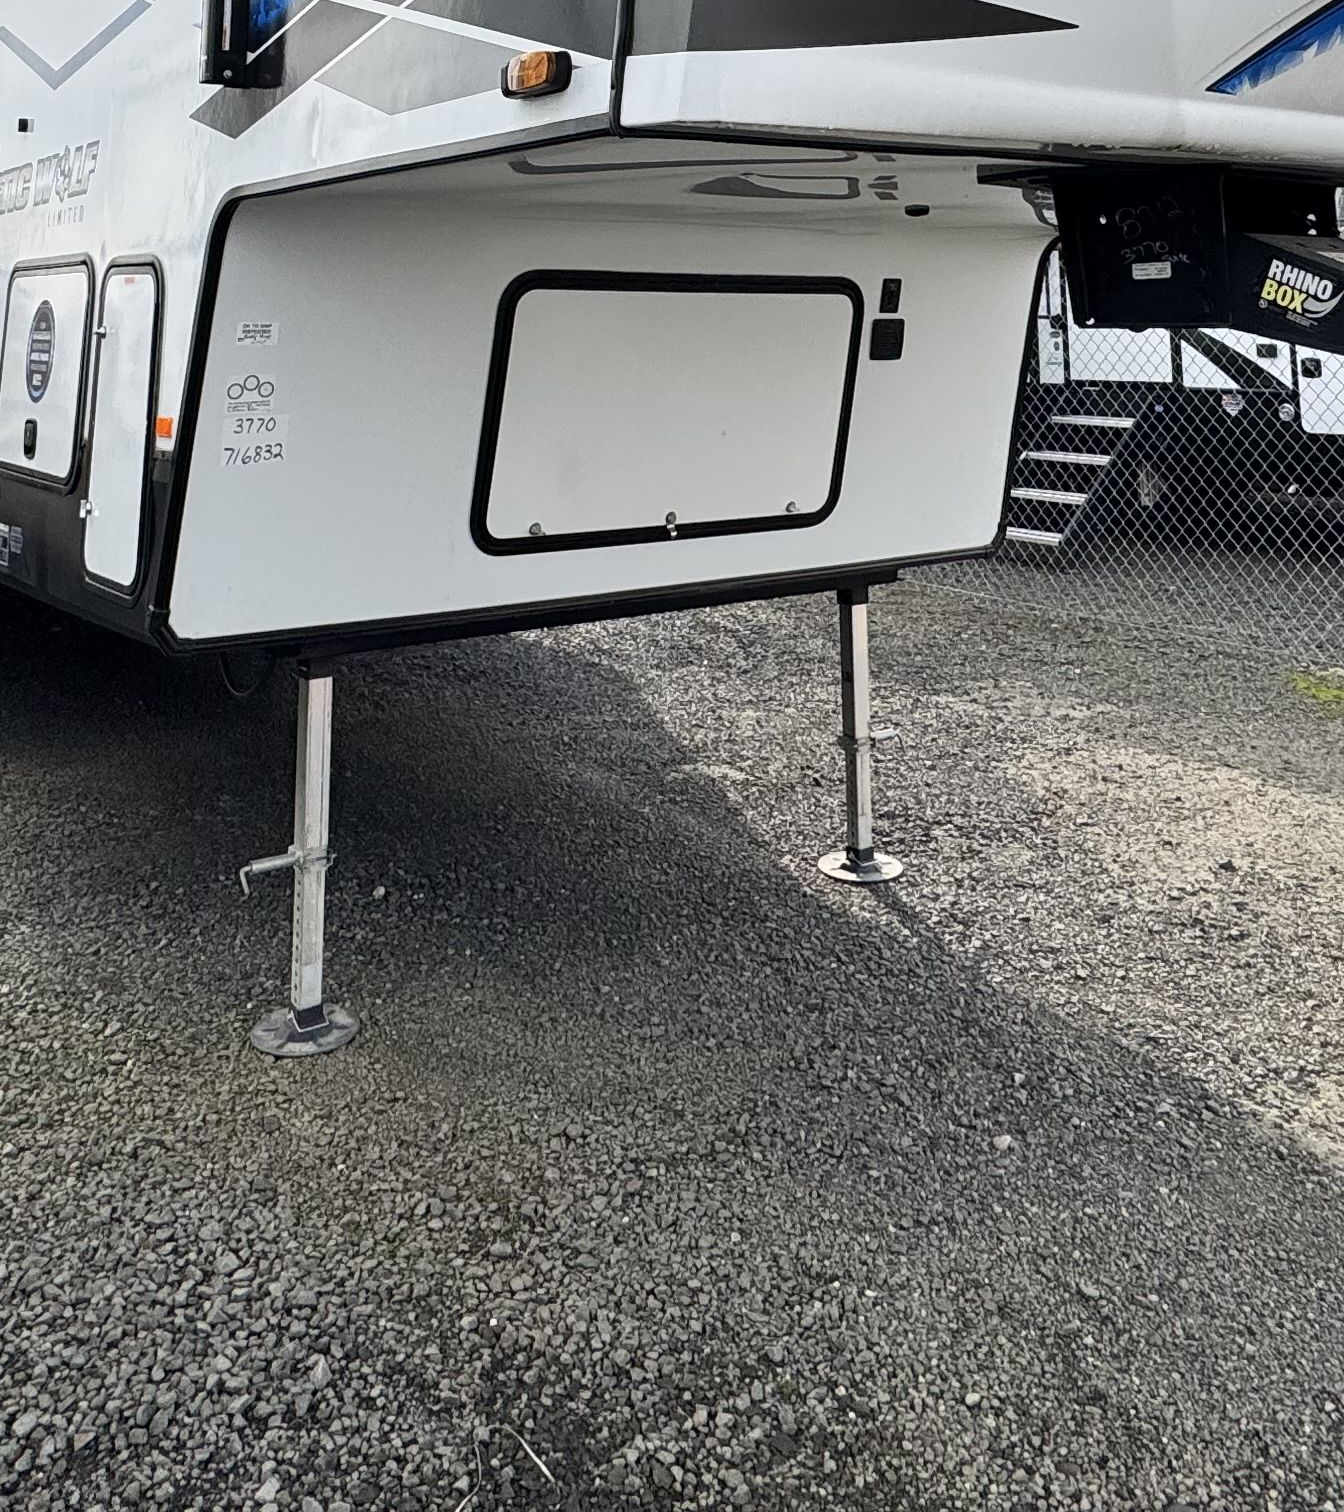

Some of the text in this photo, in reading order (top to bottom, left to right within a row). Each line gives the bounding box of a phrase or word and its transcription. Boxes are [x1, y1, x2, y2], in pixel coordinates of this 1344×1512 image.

[47, 205, 85, 228] LIMITED
[1120, 240, 1170, 265] 3770
[1267, 258, 1334, 300] RHINO
[1260, 278, 1308, 314] BOX
[233, 416, 277, 435] 3770
[223, 442, 284, 466] 716832
